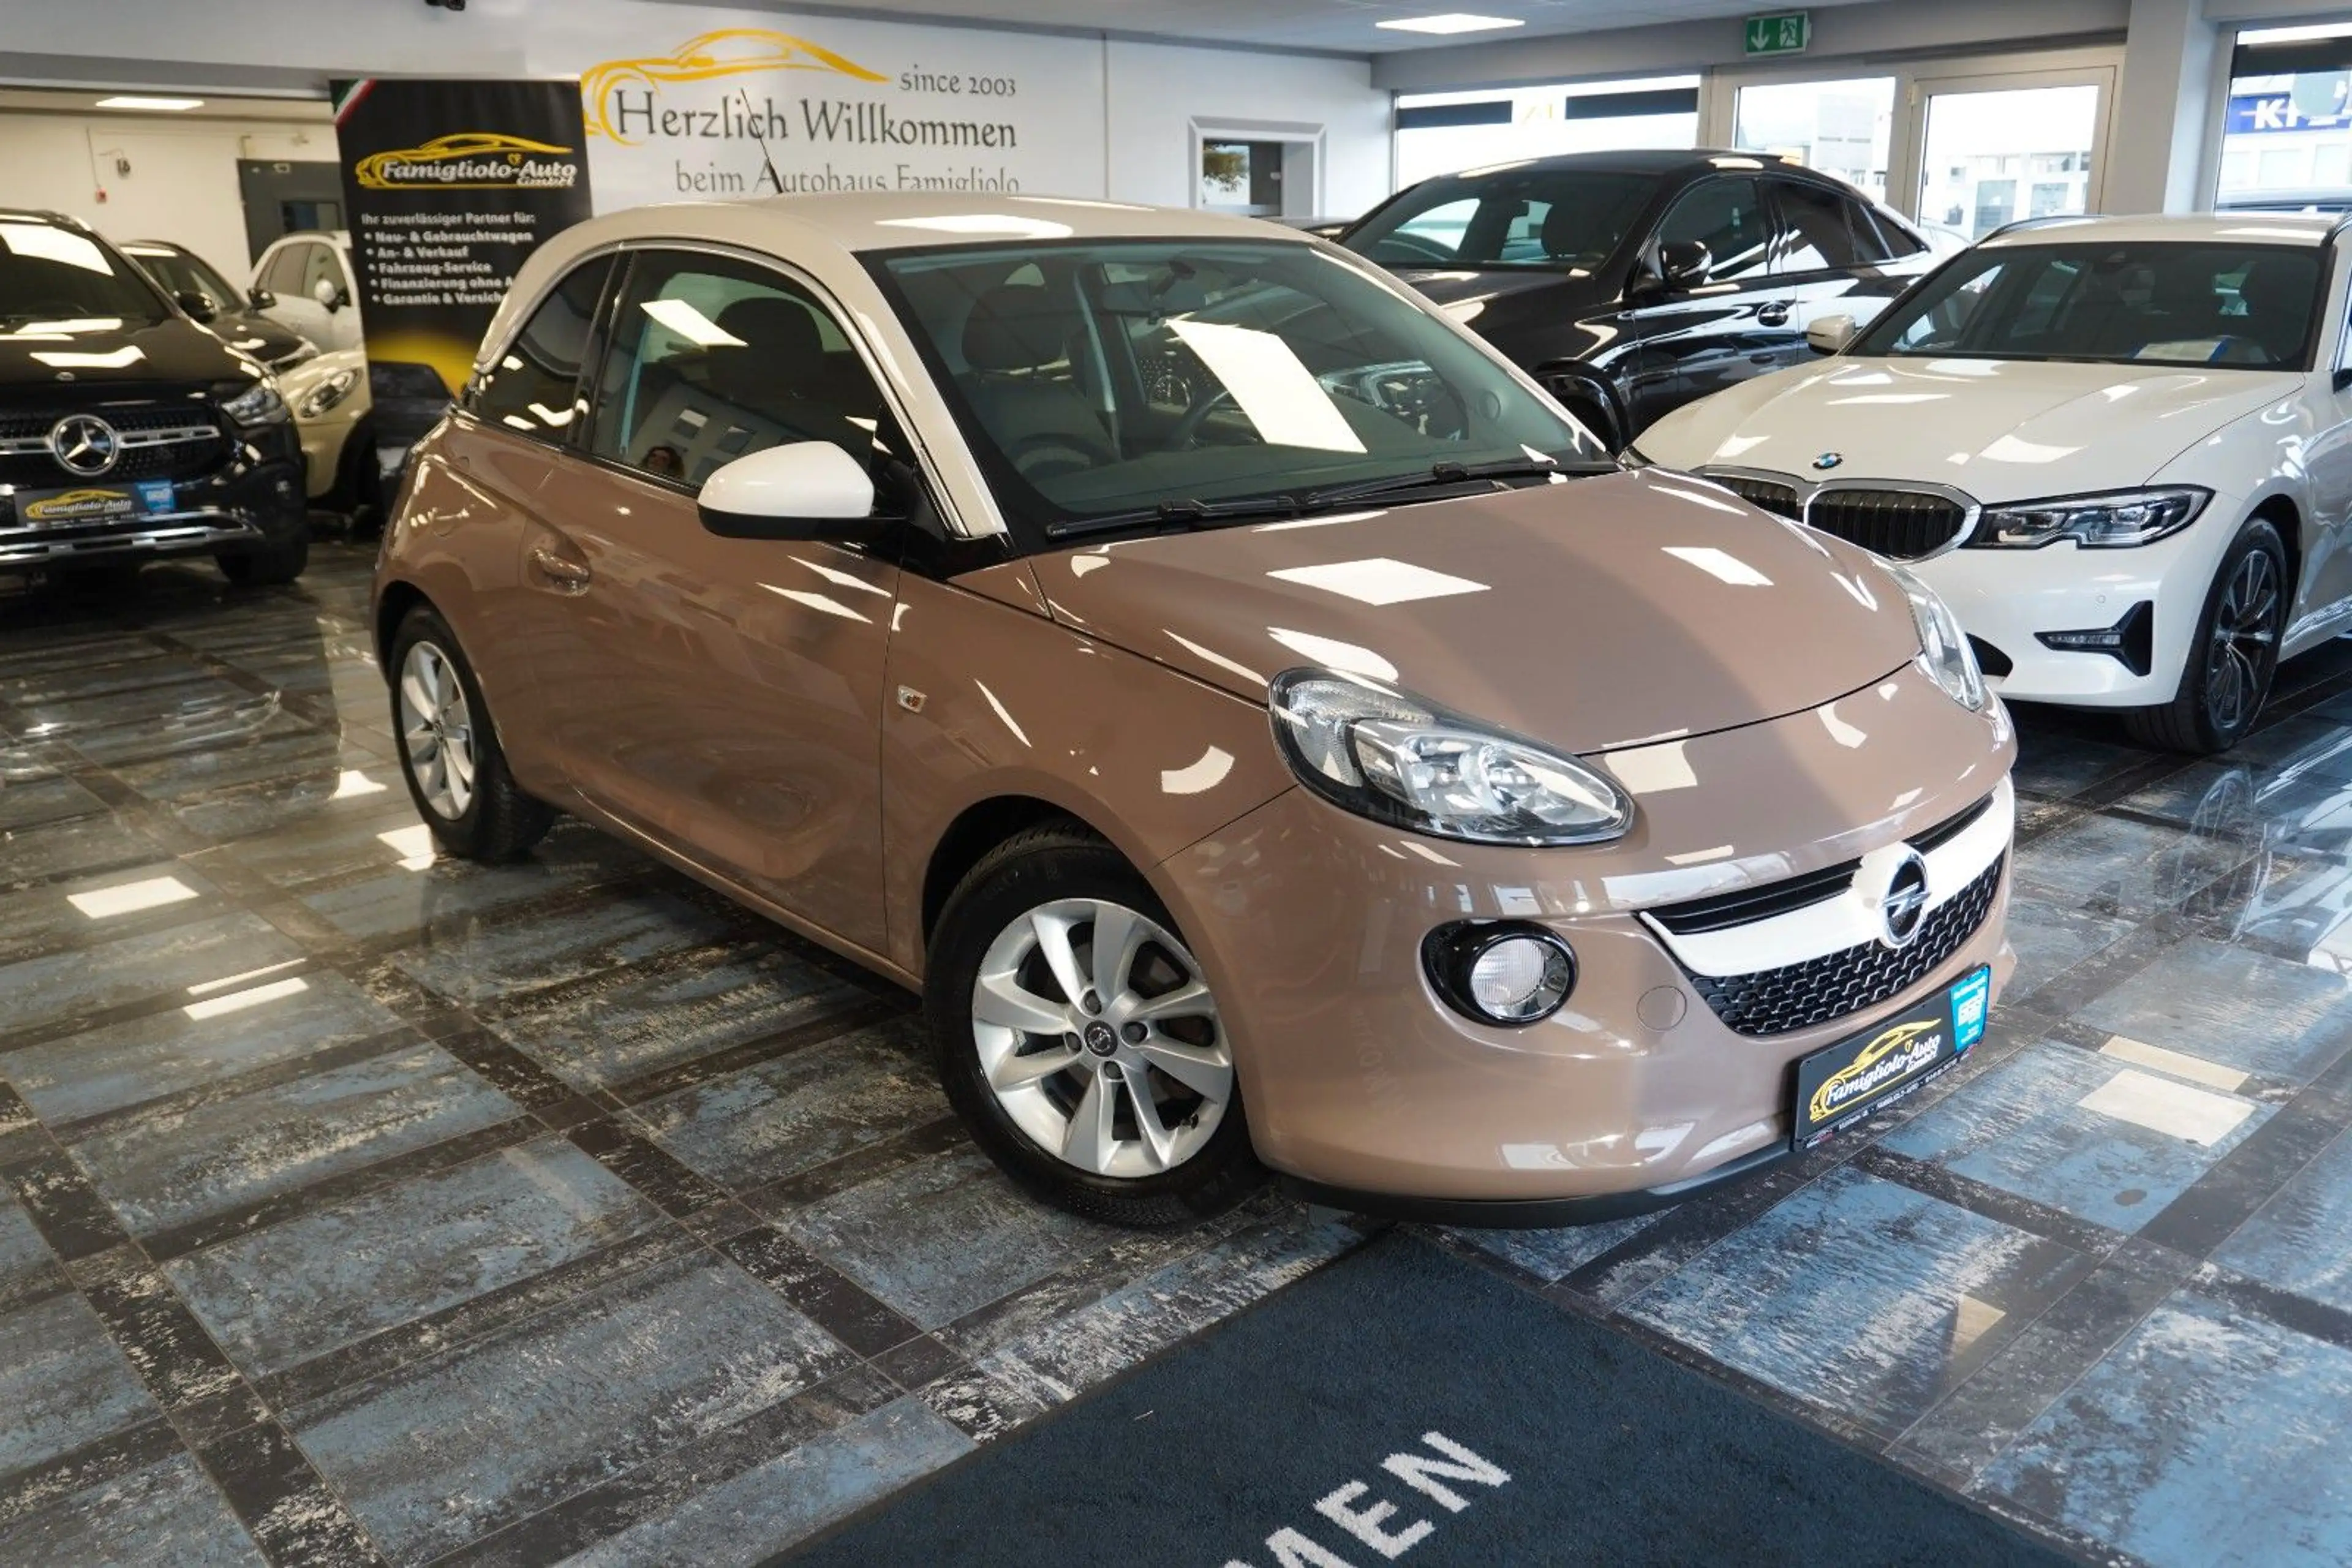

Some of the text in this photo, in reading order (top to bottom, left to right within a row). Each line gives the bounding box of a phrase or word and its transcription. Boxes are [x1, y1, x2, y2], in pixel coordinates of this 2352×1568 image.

[900, 63, 1016, 96] since 2003
[614, 89, 1017, 148] Herzlich Willkommen
[675, 158, 745, 192] beim
[361, 211, 536, 227] Ihr zuverlässiger Partner für:
[375, 230, 534, 244] Neu- & Gebrauchtwagen
[377, 245, 470, 258] An- & Verkauf
[379, 261, 492, 277] Fahrzeug-Service
[380, 276, 468, 291] Finanzierung
[469, 276, 502, 288] ohne
[383, 290, 504, 305] Garantie & Versich
